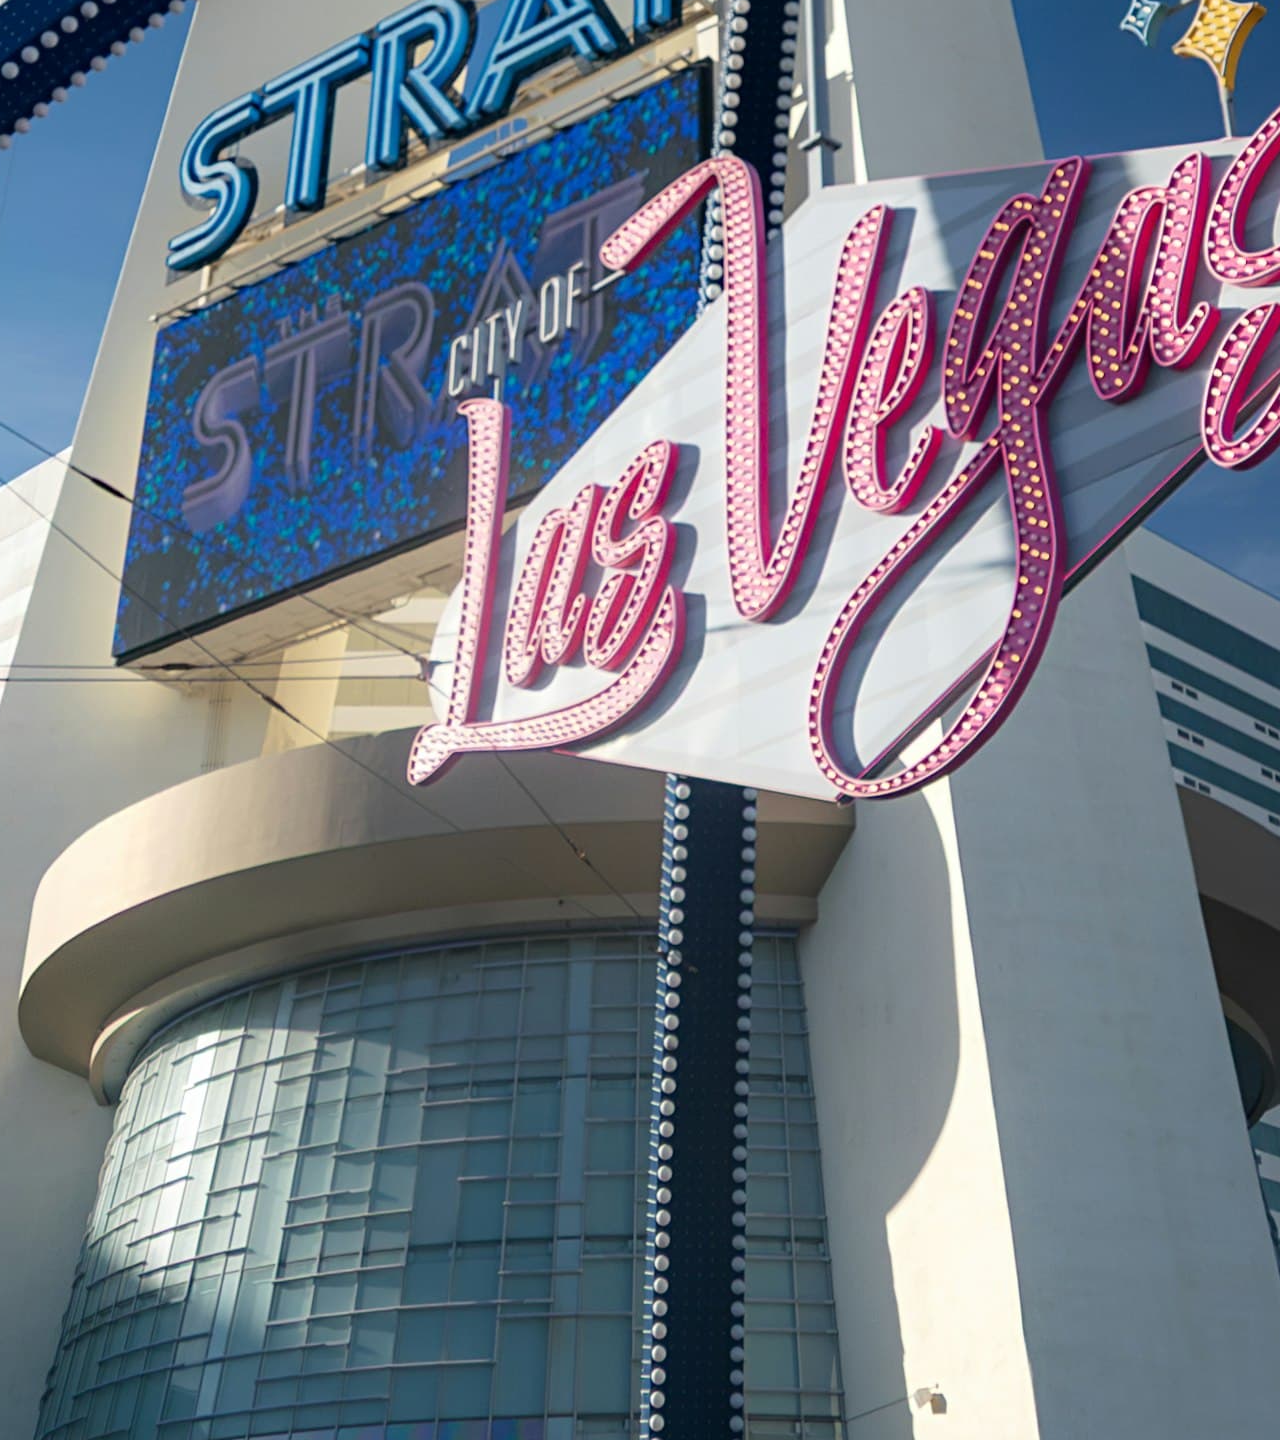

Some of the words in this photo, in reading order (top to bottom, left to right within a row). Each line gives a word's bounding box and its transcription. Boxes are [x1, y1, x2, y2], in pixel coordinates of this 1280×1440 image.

[182, 173, 646, 528] STRAT
[448, 299, 522, 397] CITY
[539, 260, 584, 344] OF
[406, 398, 685, 786] Las
